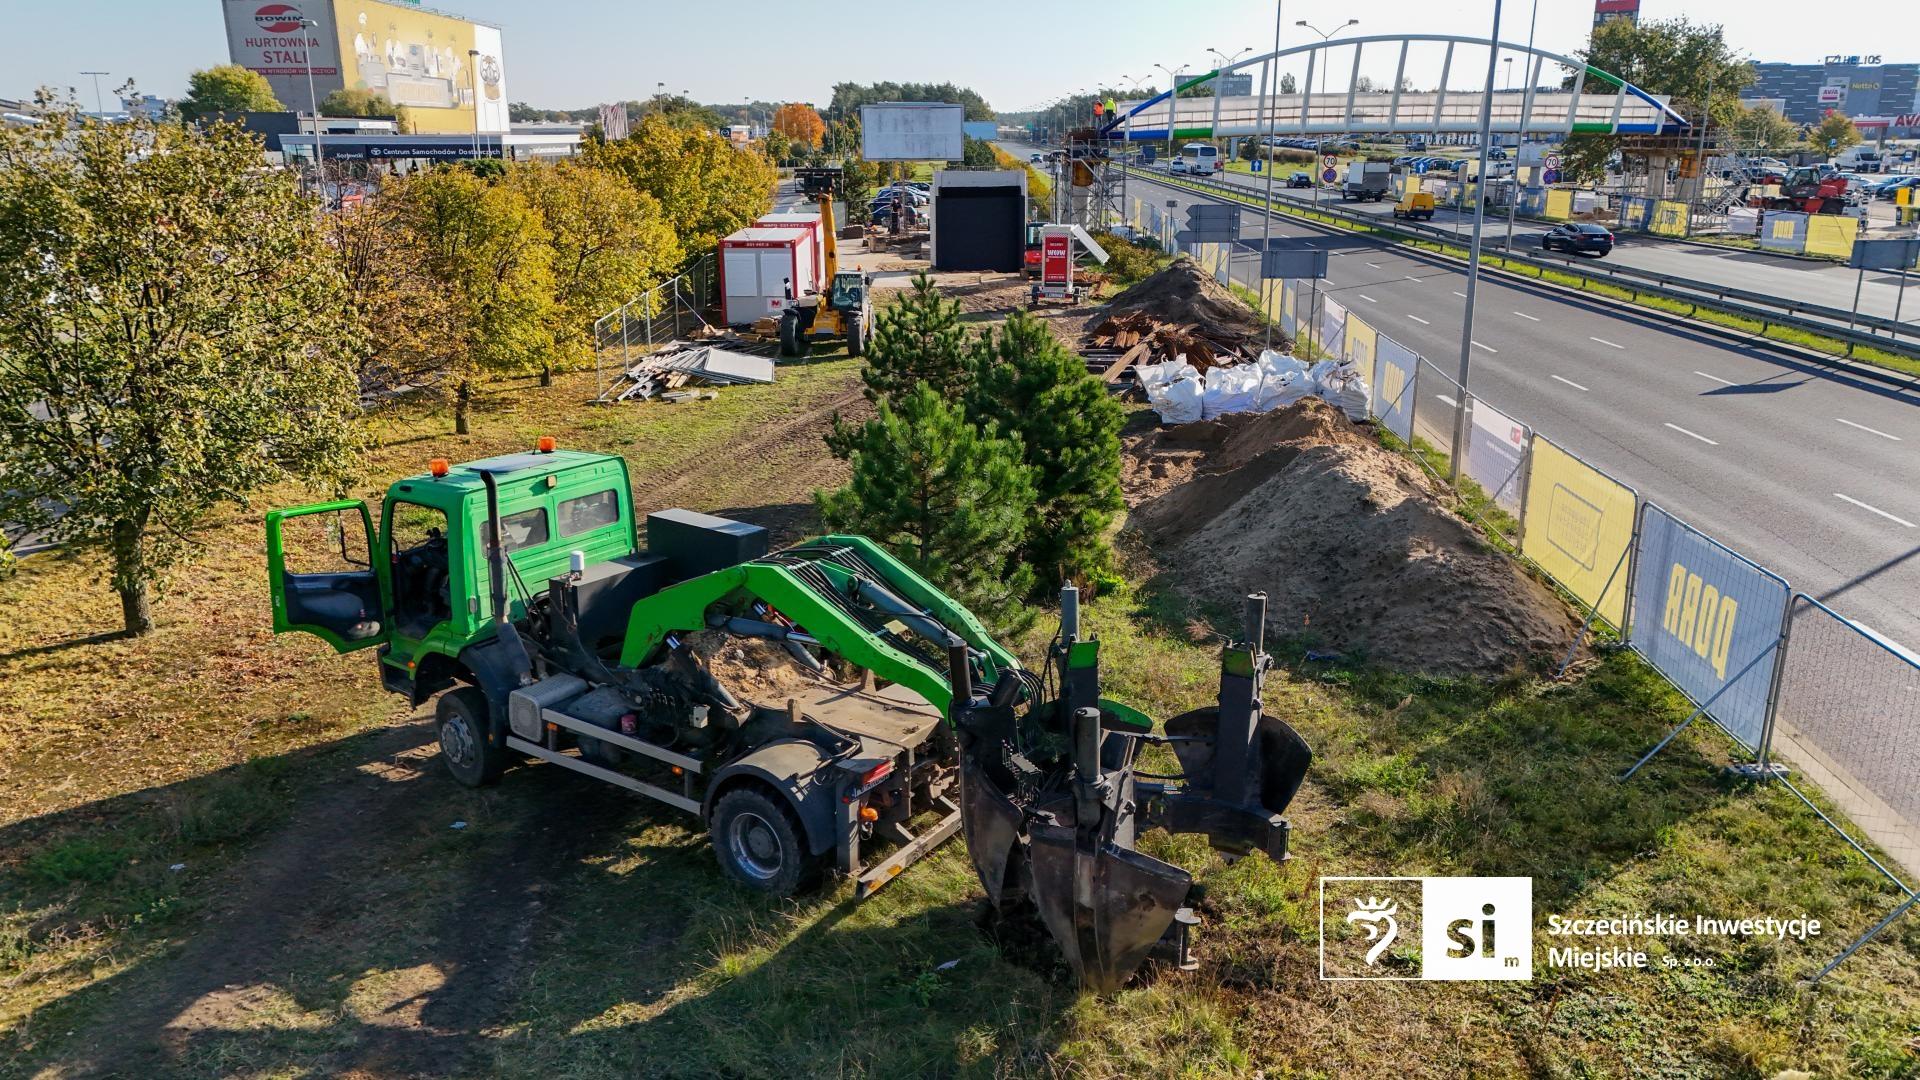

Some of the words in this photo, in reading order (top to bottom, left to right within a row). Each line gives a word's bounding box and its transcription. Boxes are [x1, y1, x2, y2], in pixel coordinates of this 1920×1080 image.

[245, 38, 319, 47] HURTOWNIA
[263, 51, 308, 63] STALI
[1895, 112, 1920, 127] AVI
[1326, 157, 1335, 165] 70
[1548, 158, 1557, 166] 70
